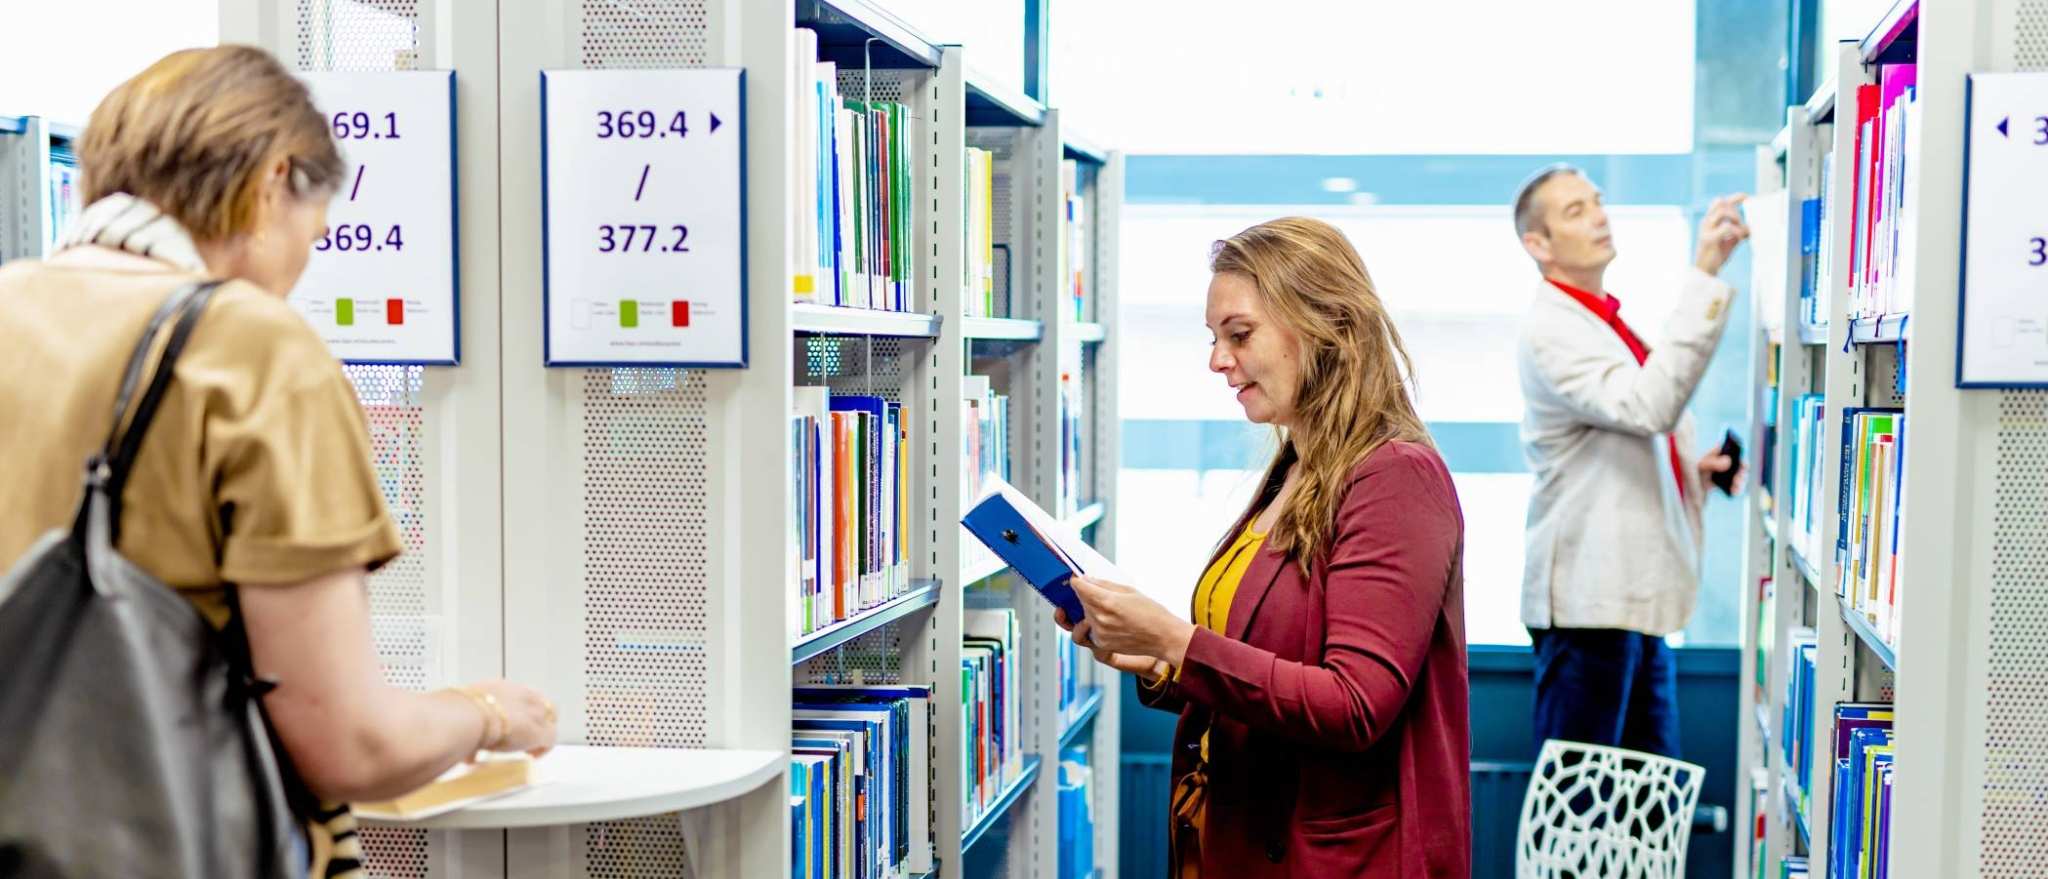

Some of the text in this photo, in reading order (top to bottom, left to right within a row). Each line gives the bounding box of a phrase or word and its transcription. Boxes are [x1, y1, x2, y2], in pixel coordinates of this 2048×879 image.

[332, 112, 401, 139] 69.1
[597, 110, 689, 139] 369.4
[350, 164, 365, 202] /
[635, 164, 651, 202] /
[599, 224, 689, 251] 377.2
